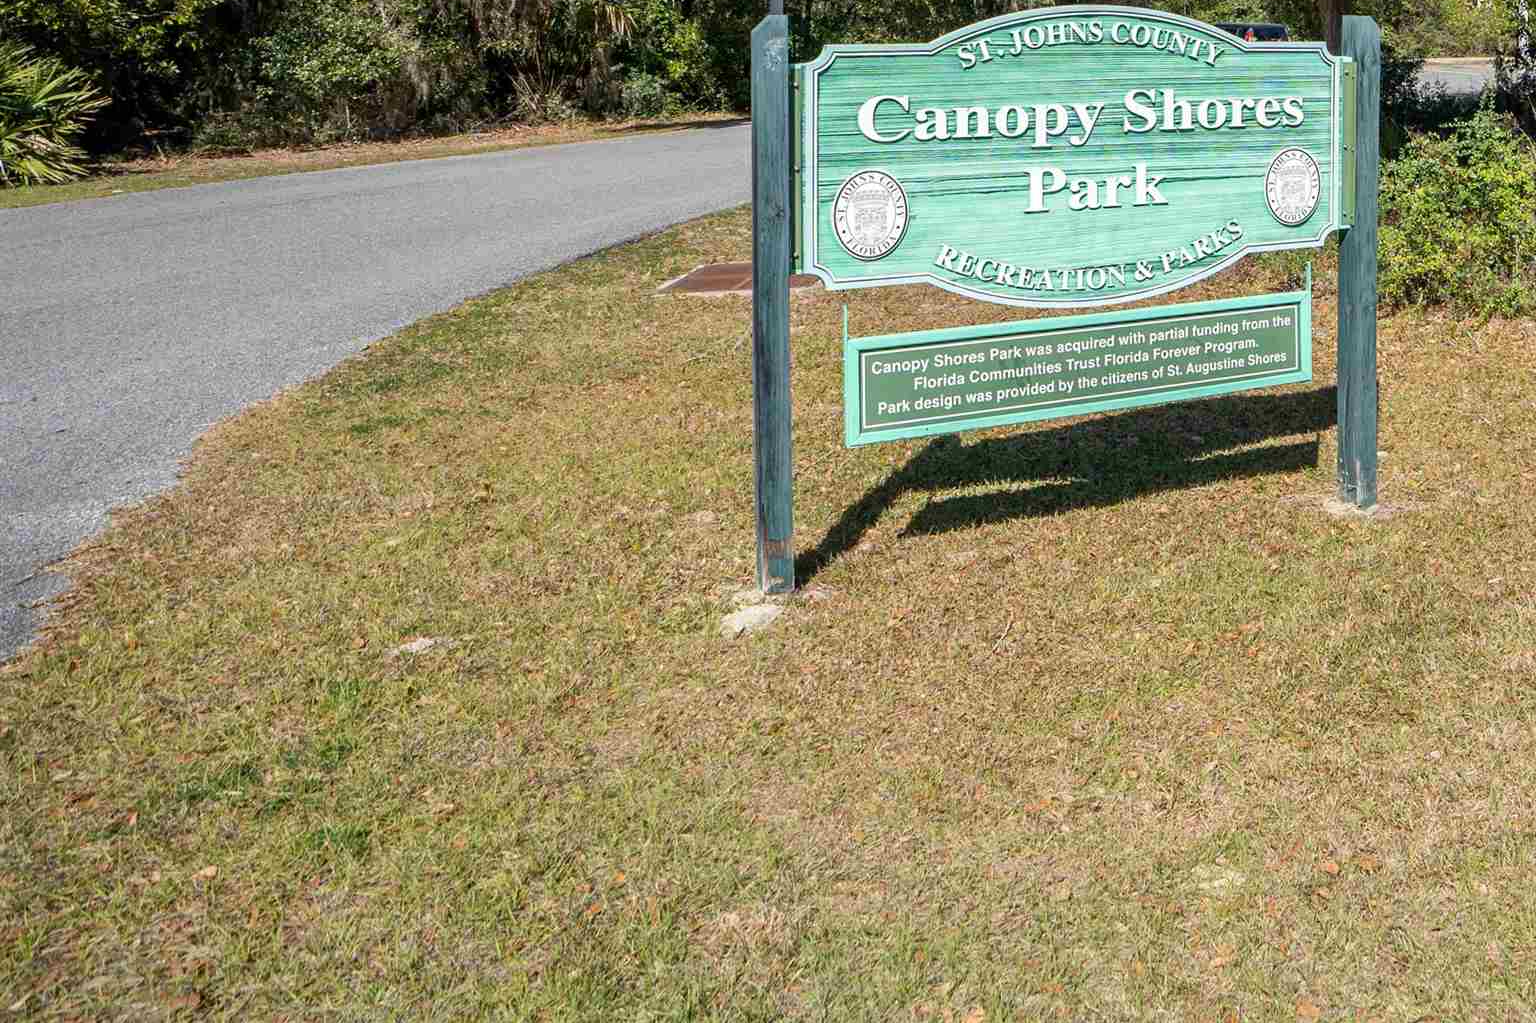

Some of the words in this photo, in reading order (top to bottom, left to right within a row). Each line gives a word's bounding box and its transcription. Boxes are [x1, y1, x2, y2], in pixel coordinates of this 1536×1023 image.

[957, 37, 1005, 69] ST.
[1009, 21, 1104, 56] JOHNS
[1111, 23, 1225, 67] COUNTY
[856, 94, 1105, 149] Canopy
[1123, 88, 1306, 133] Shores
[1023, 163, 1169, 213] Park
[933, 244, 1127, 291] RECREATION
[1134, 259, 1155, 282] &
[1159, 218, 1244, 274] PARKS
[871, 358, 929, 375] Canopy
[934, 352, 985, 368] Shores
[990, 346, 1022, 361] Park
[1025, 344, 1053, 356] was
[1057, 335, 1115, 353] acquired
[1119, 330, 1146, 345] with
[1149, 327, 1189, 344] partial
[1192, 321, 1239, 337] funding
[1242, 318, 1269, 330] from
[1272, 316, 1291, 327] the
[914, 373, 965, 390] Florida
[969, 361, 1062, 383] Communities
[1066, 356, 1100, 371] Trust
[1104, 350, 1149, 366] Florida
[1153, 344, 1200, 361] Forever
[1204, 337, 1259, 355] Program.
[878, 399, 911, 415] Park
[914, 392, 962, 410] design
[966, 390, 993, 403] was
[997, 380, 1055, 401] provided
[1058, 378, 1075, 393] by
[1078, 374, 1098, 389] the
[1101, 369, 1149, 386] citizens
[1152, 365, 1164, 378] of
[1167, 364, 1184, 377] St.
[1186, 356, 1245, 375] Augustine
[1247, 351, 1287, 366] Shores
